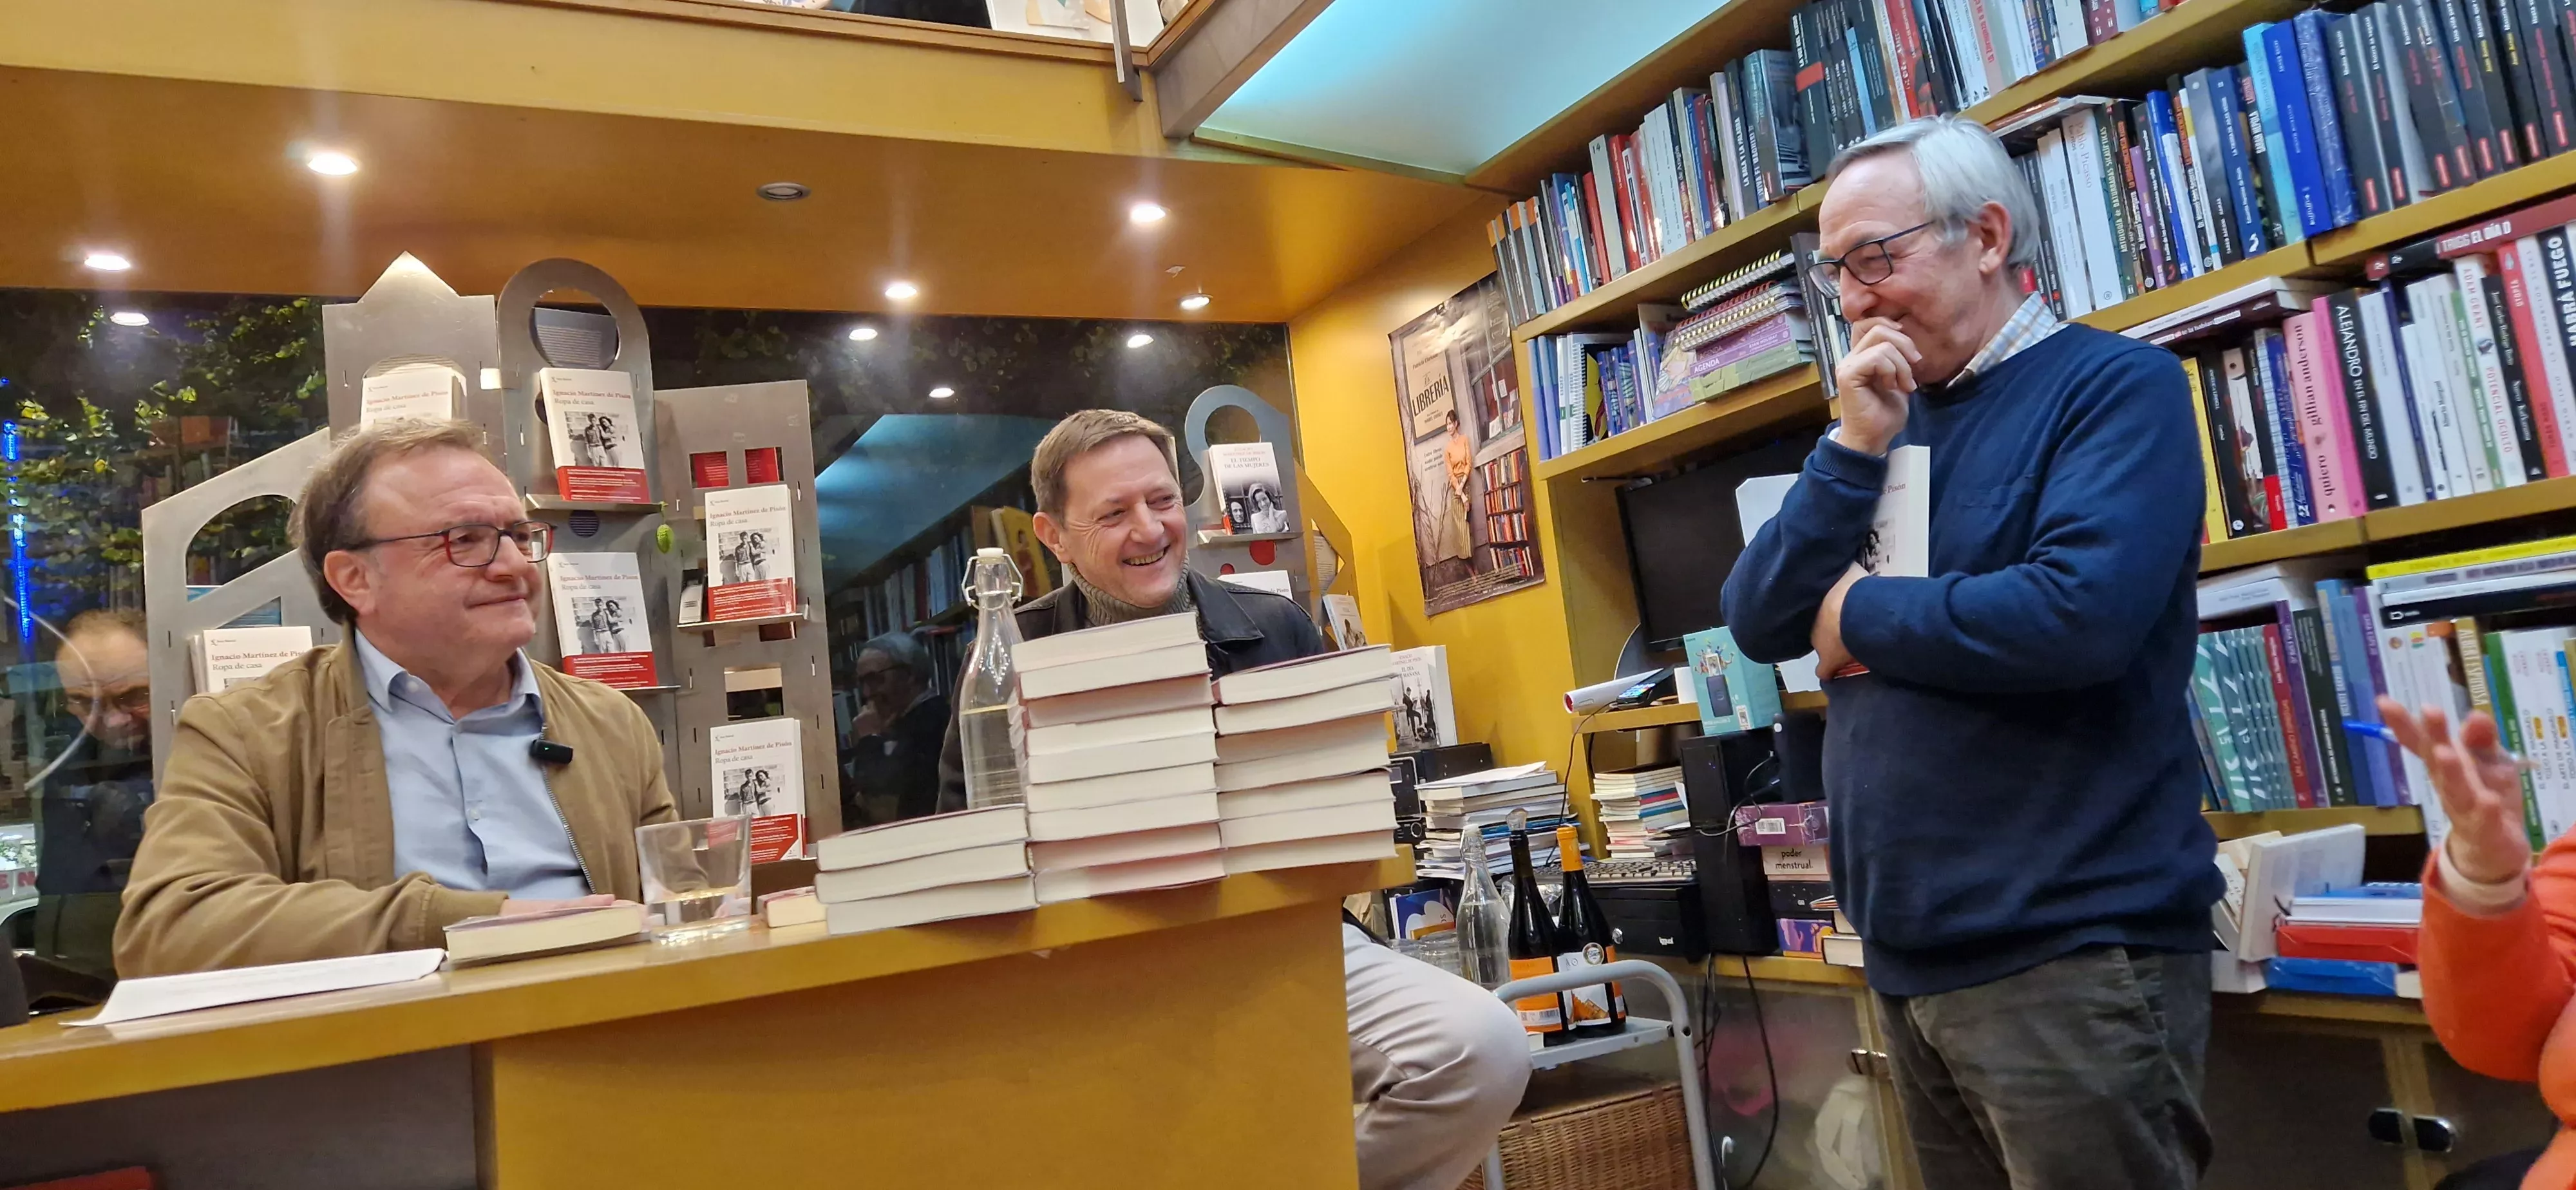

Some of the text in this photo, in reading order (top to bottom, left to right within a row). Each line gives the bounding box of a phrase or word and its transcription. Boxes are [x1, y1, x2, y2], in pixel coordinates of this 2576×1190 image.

[1734, 117, 1744, 146] PALABRA
[1738, 146, 1746, 155] LA
[2075, 122, 2092, 189] Pablo Picasso
[1739, 160, 1749, 178] BALA
[1743, 178, 1750, 187] LA
[2470, 230, 2484, 243] EL
[2503, 220, 2512, 234] D
[2547, 236, 2572, 290] FUEGO
[2463, 269, 2477, 296] ADAM
[1694, 358, 1720, 374] AGENDA
[2294, 324, 2323, 426] gillian anderson
[1411, 373, 1450, 417] LIBRERÍA
[2336, 305, 2363, 377] ALEJANDRO
[2363, 430, 2378, 460] MUNDO
[2485, 366, 2513, 453] POTENCIAL OCULTO
[2318, 454, 2335, 497] quiero
[1888, 484, 1906, 494] Pisón
[211, 653, 242, 661] Ignacio
[2559, 764, 2568, 782] ARTE
[1781, 847, 1803, 861] poder
